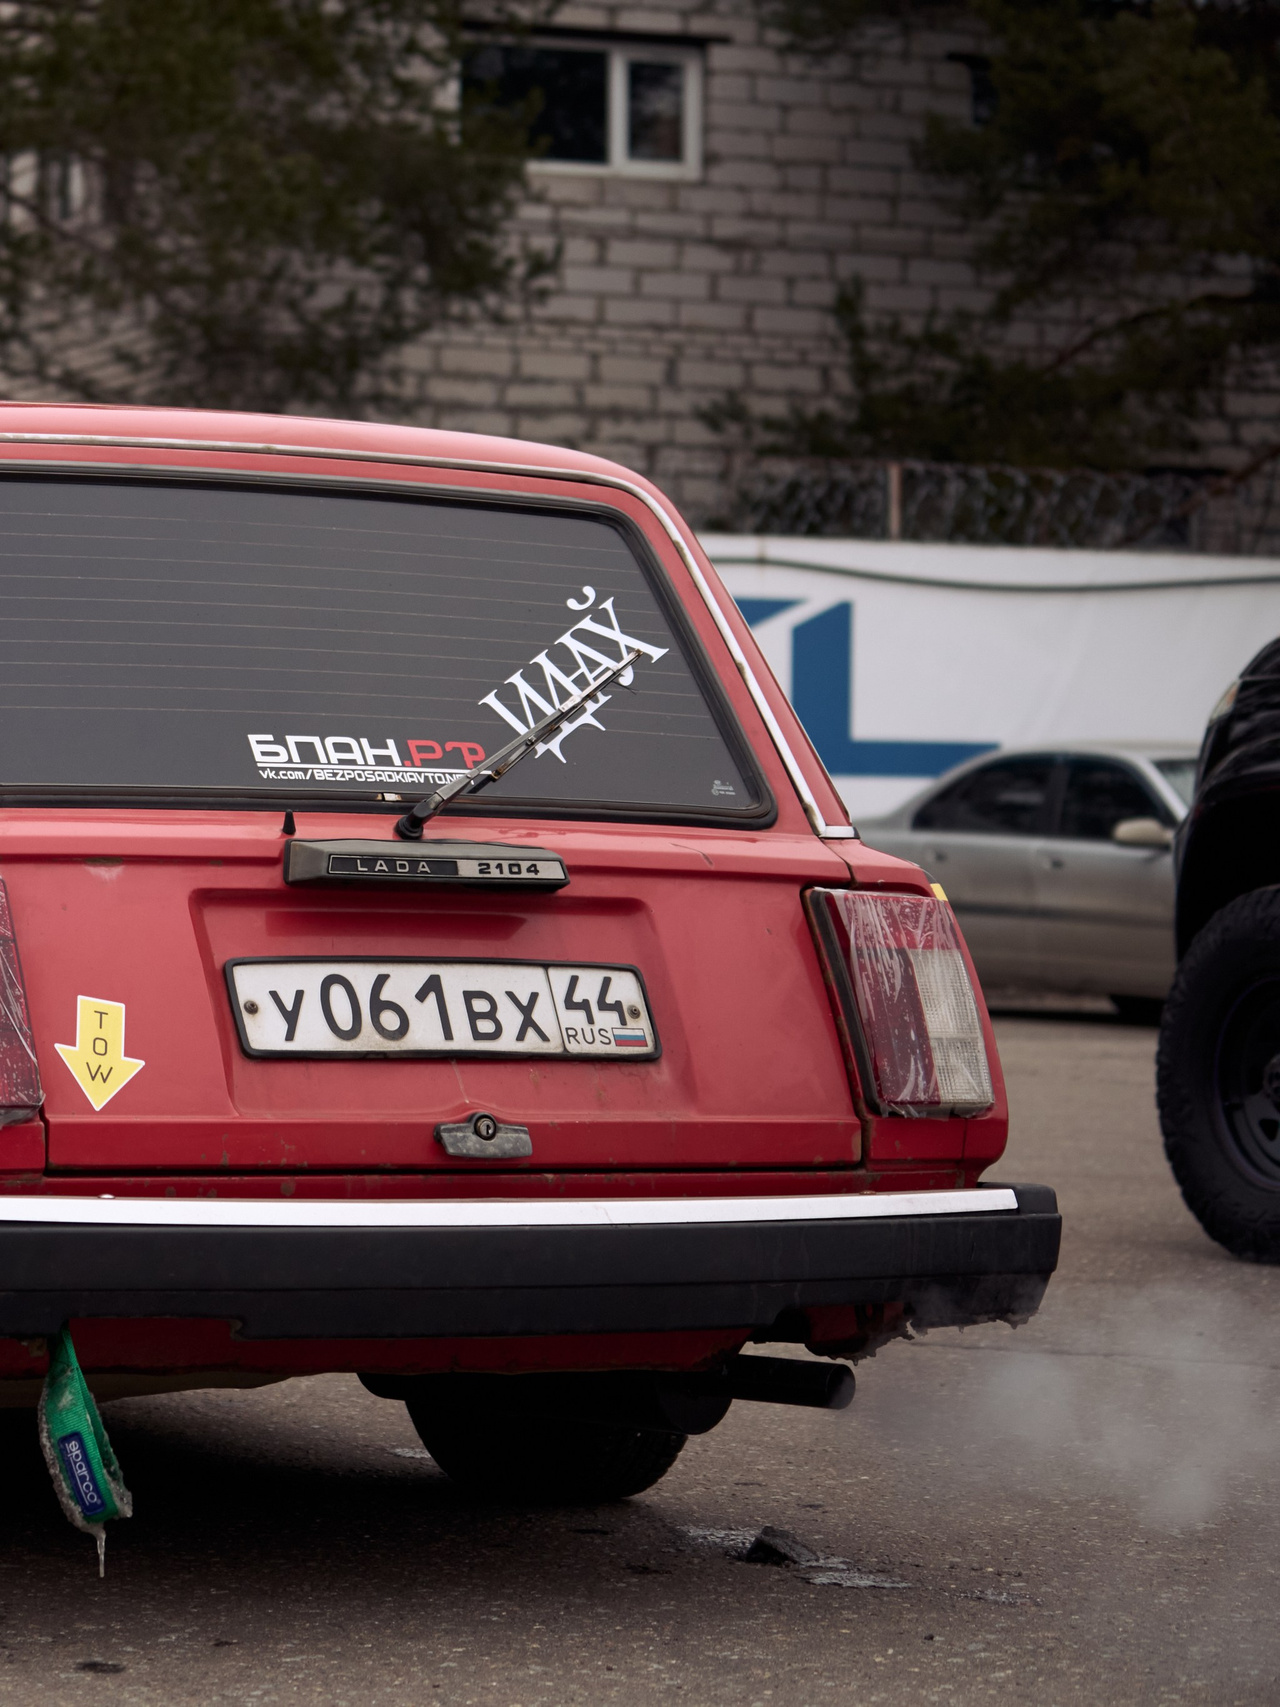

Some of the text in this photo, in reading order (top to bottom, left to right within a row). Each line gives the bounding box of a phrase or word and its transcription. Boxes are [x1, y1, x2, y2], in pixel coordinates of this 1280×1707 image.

[259, 768, 475, 786] vk.com/BEZPOSADKIAVTO.N
[356, 859, 541, 876] LADA 2104
[564, 974, 628, 1027] 44
[85, 1010, 114, 1085] TOW
[565, 1027, 612, 1046] RUS
[66, 1440, 99, 1505] sparco
